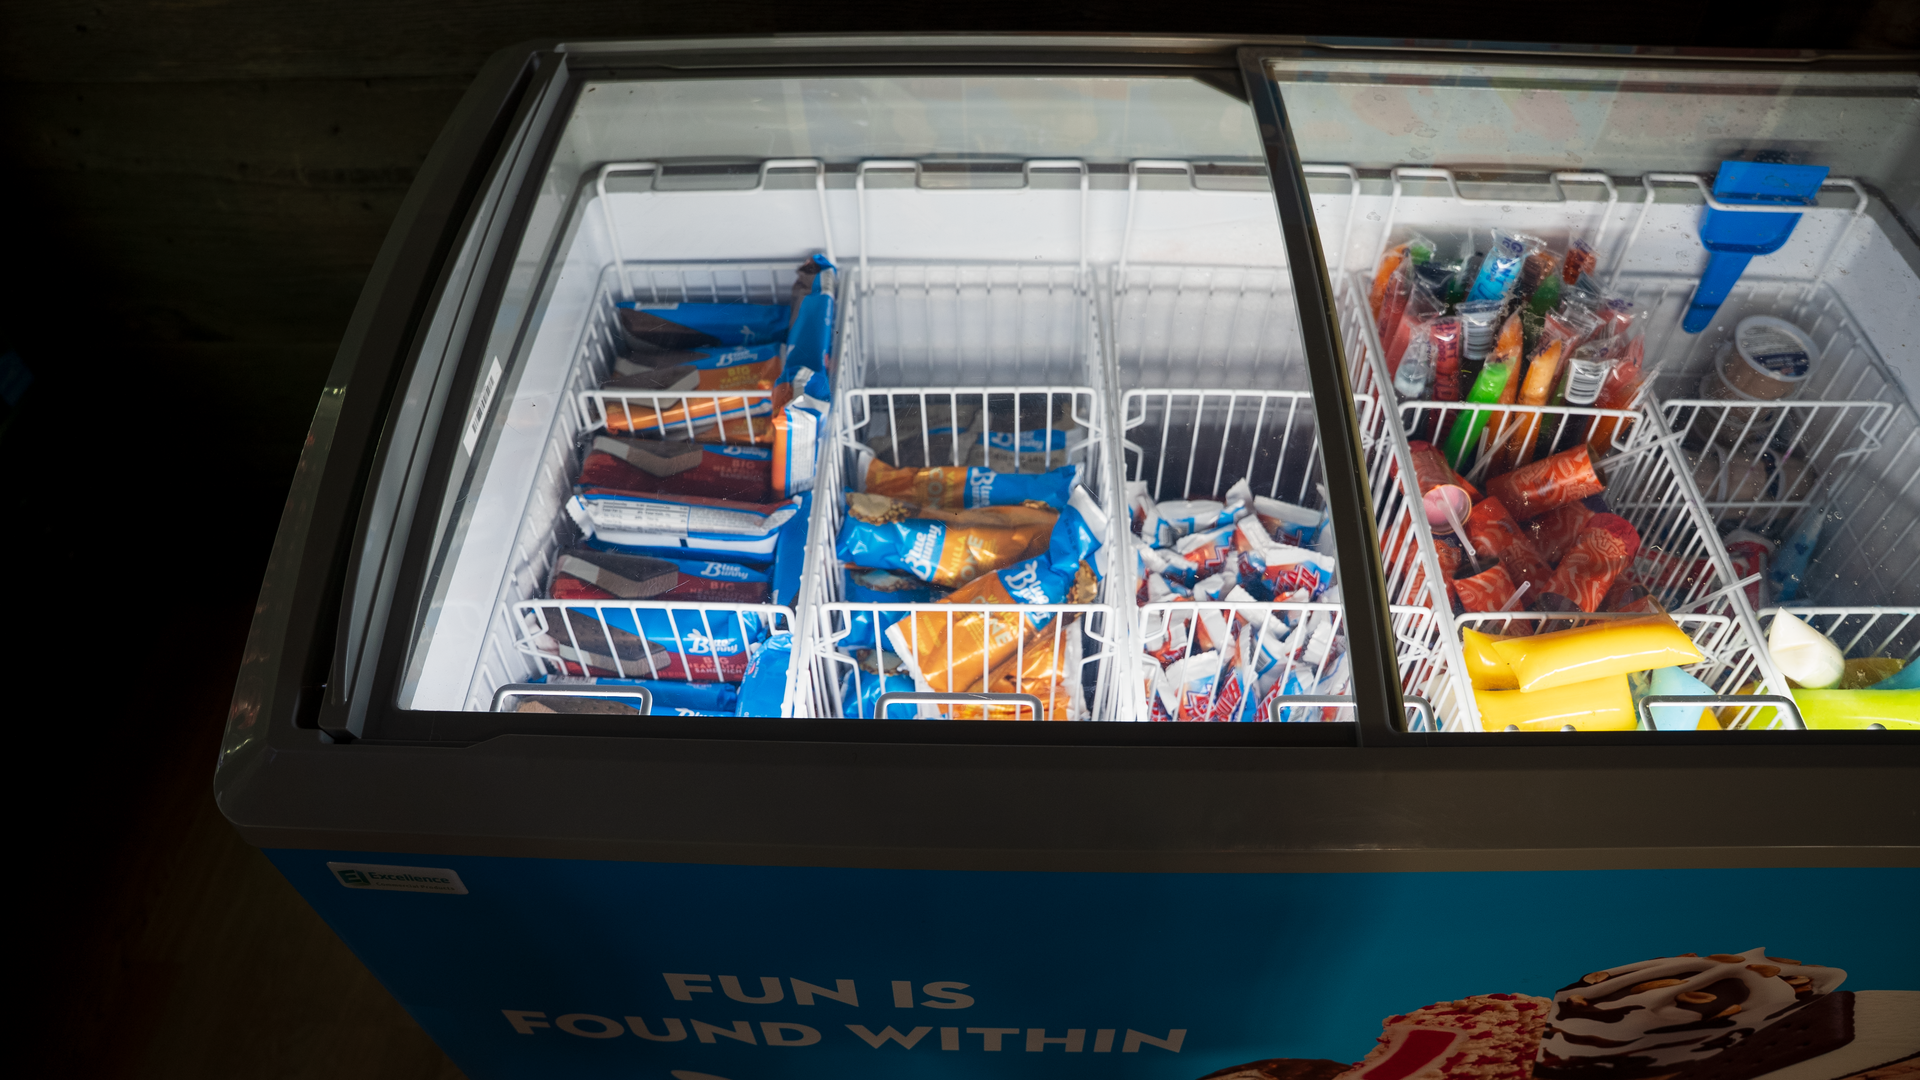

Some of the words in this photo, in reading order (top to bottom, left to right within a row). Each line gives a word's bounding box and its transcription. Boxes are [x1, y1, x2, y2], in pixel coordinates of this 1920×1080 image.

[928, 467, 944, 511] CON
[905, 523, 943, 582] Bunny
[710, 582, 735, 590] BIG
[971, 595, 1013, 647] CNE
[368, 872, 451, 884] Excellence
[662, 972, 860, 1008] FUN
[891, 980, 975, 1010] IS
[501, 1008, 822, 1047] FOUND
[844, 1023, 1188, 1054] WITHIN
